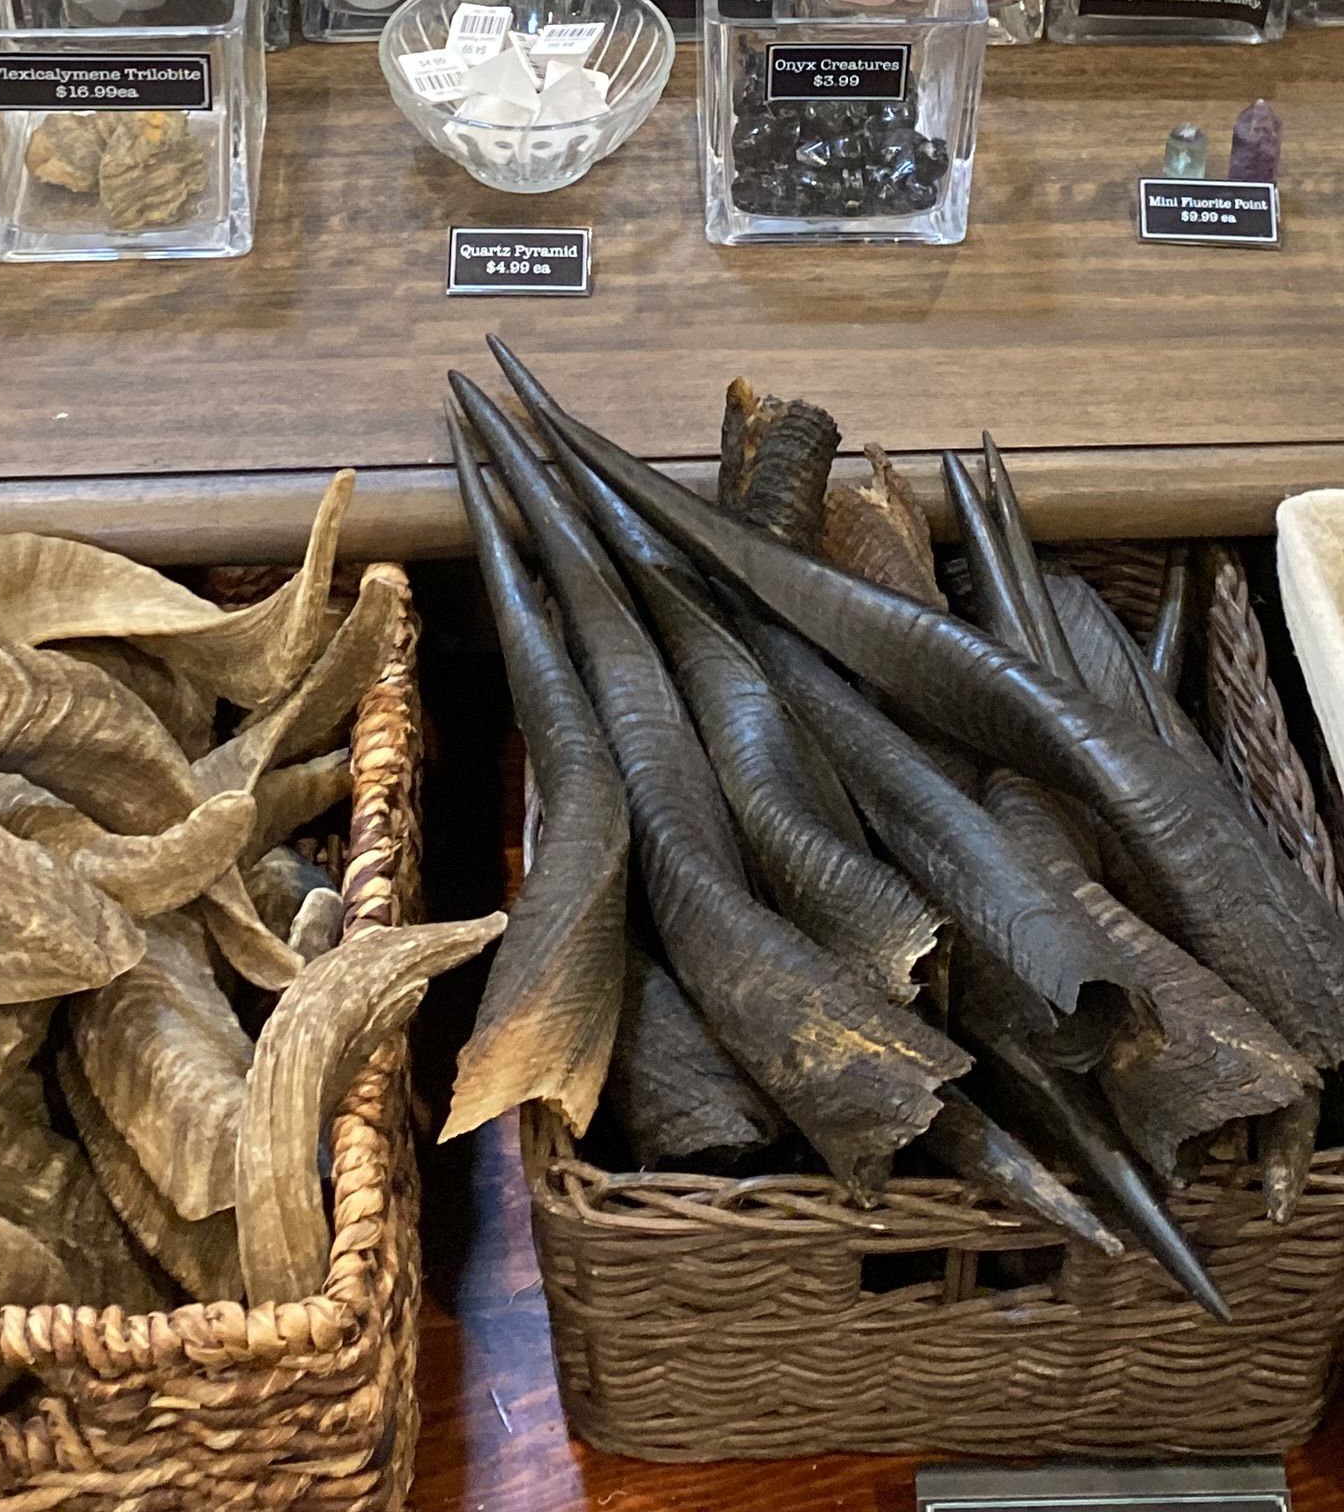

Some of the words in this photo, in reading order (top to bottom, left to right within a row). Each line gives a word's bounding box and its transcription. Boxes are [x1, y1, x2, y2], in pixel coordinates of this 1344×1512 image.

[775, 59, 816, 73] Onyx
[820, 59, 899, 70] Creatures
[124, 68, 201, 80] Trilobite
[813, 74, 860, 87] $3.99
[56, 86, 139, 99] $16.99ea
[1149, 196, 1178, 207] Mini
[1181, 197, 1232, 209] Fluorite
[1234, 199, 1268, 210] Point
[1181, 211, 1218, 222] $9.99
[1221, 214, 1237, 223] ea
[460, 244, 511, 259] Quartz
[514, 245, 578, 259] Pyramid
[486, 260, 530, 274] $4.99
[533, 264, 551, 274] ea
